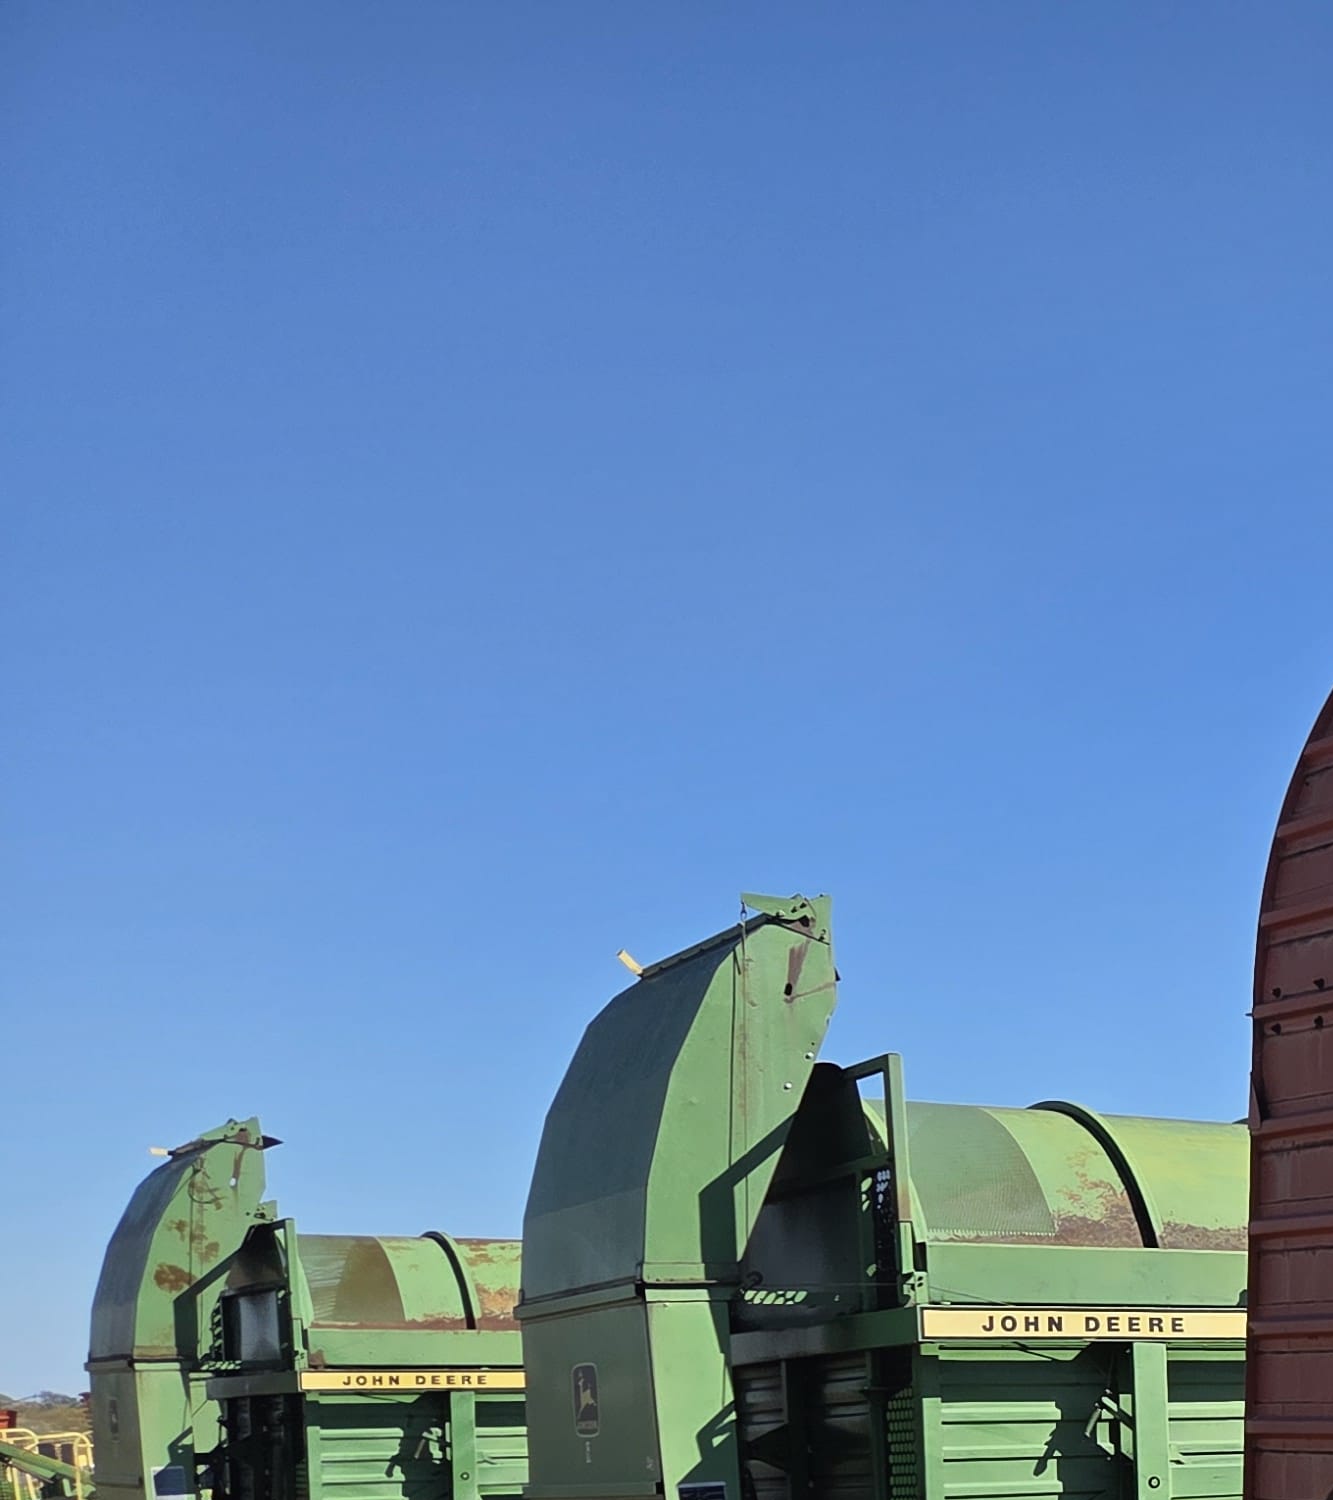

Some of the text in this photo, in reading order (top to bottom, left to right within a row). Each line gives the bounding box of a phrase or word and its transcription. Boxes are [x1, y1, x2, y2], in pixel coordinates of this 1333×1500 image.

[981, 1315, 1185, 1333] JOHN DEERE
[342, 1375, 488, 1386] JOHN DEERE
